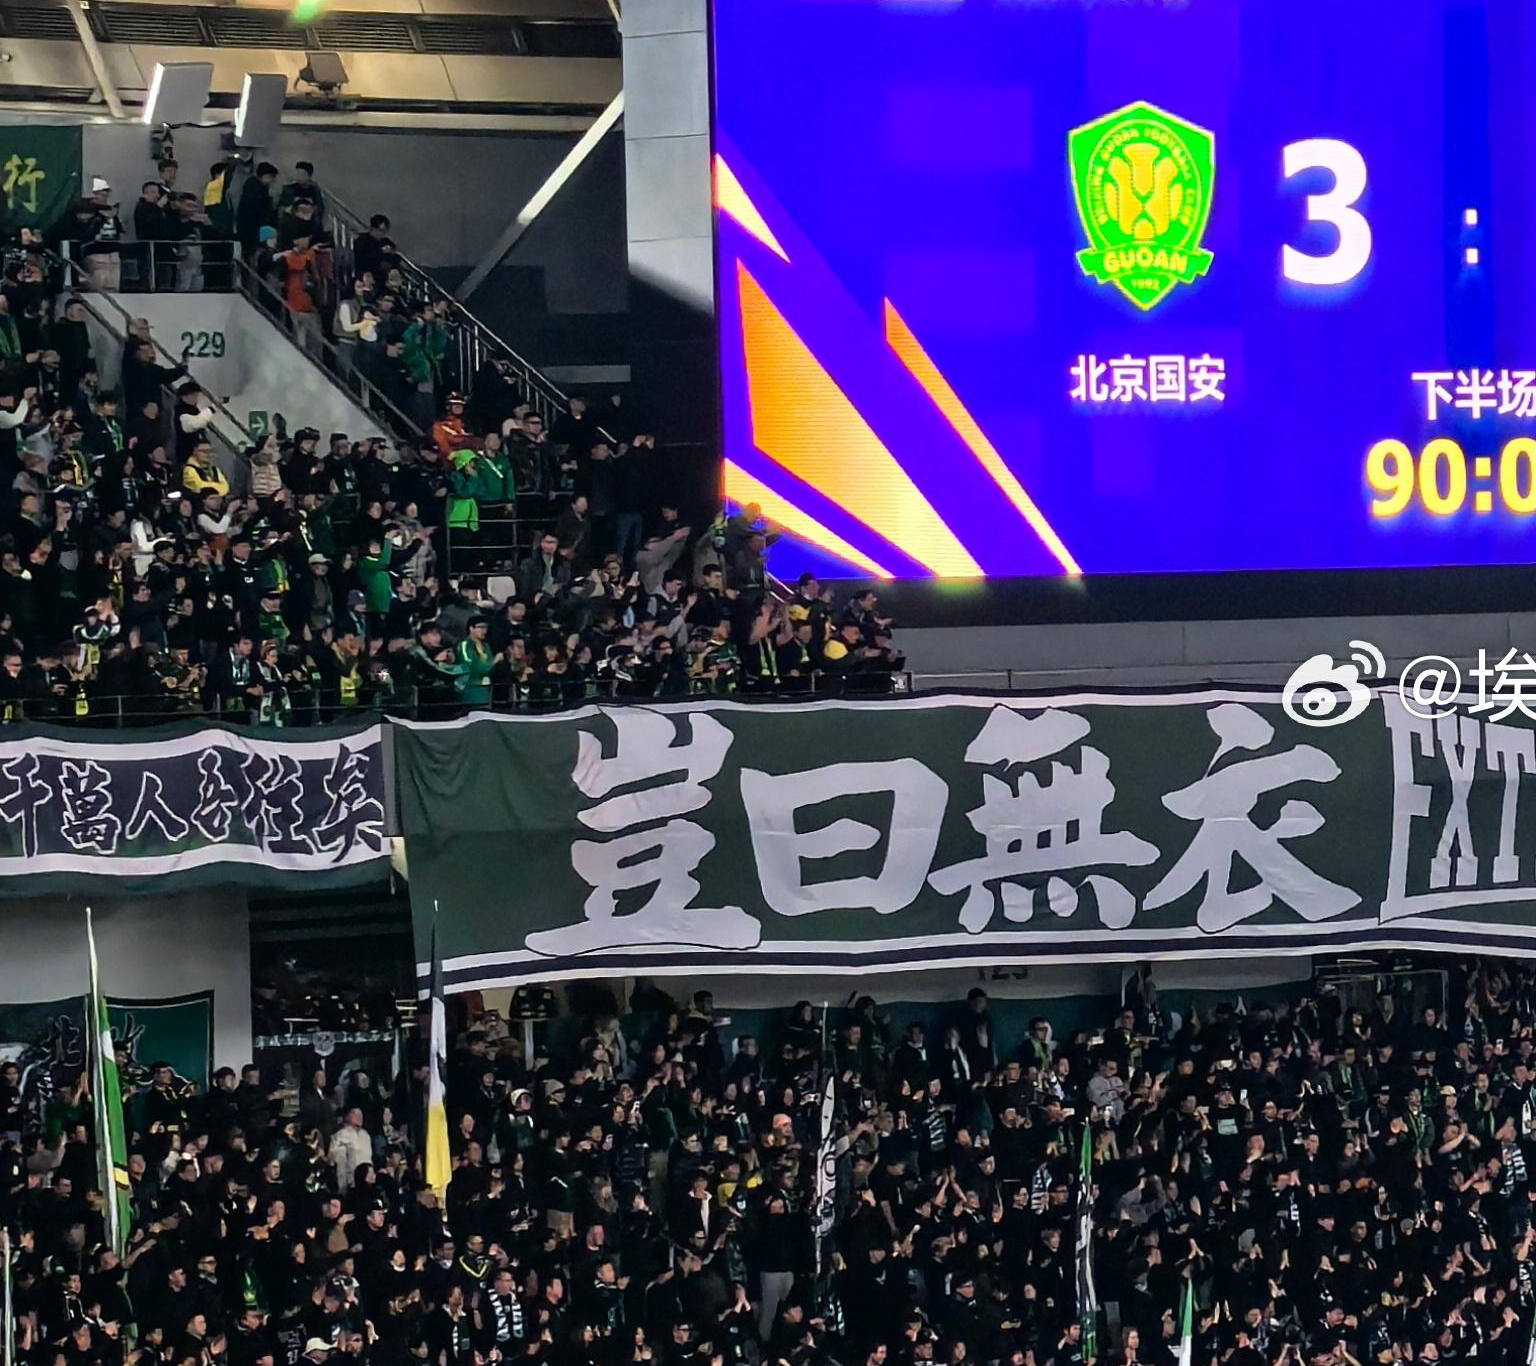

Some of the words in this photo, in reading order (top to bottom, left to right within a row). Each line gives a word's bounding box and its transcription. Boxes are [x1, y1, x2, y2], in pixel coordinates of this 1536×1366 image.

[1281, 138, 1371, 286] 3
[1103, 247, 1188, 274] GUOAN
[181, 331, 225, 359] 229
[1069, 352, 1226, 403] 北京国安
